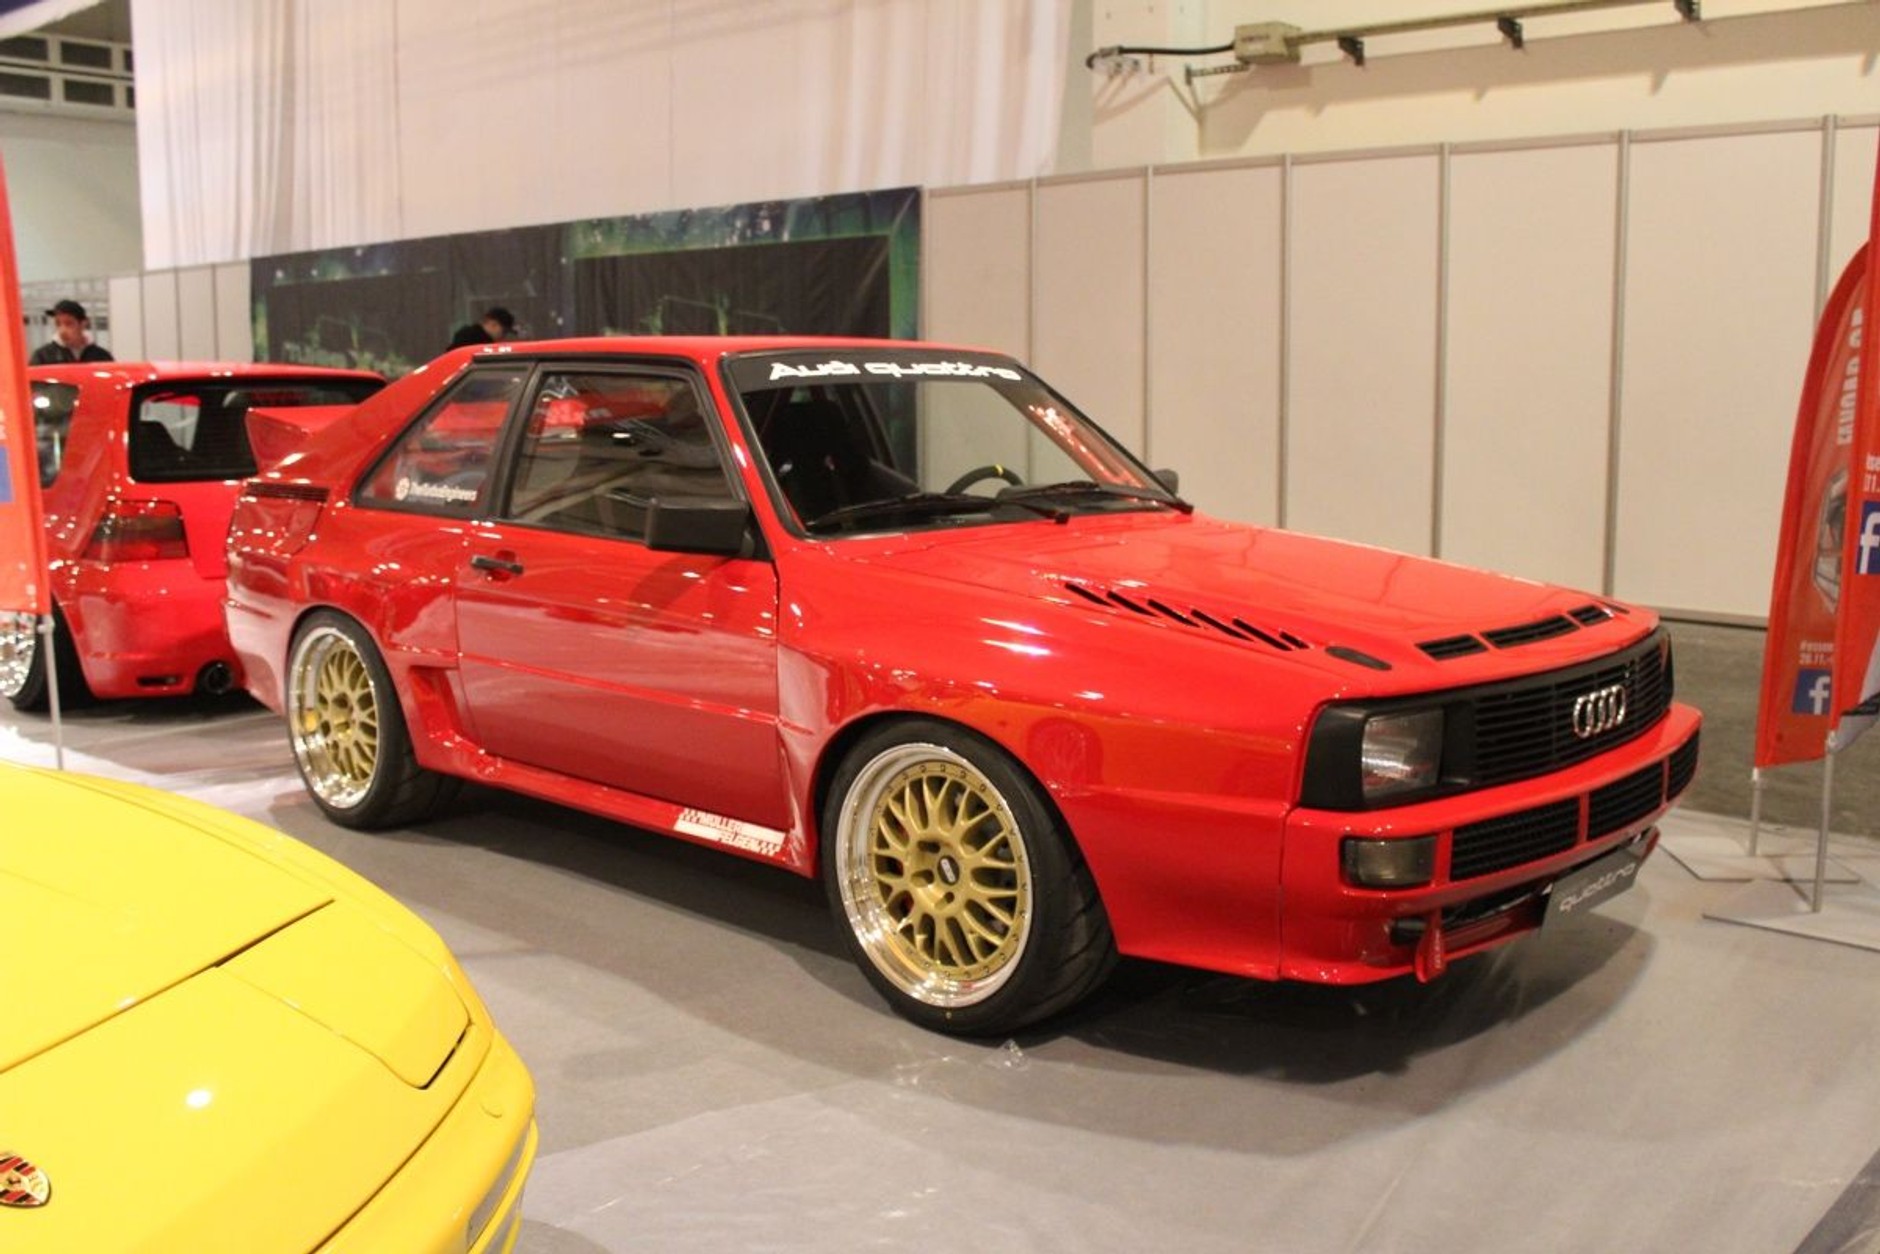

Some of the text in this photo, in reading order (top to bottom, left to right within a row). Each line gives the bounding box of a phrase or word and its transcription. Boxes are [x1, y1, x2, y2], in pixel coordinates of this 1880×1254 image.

[769, 361, 1022, 382] Audi quattro
[1559, 862, 1636, 913] quattro
